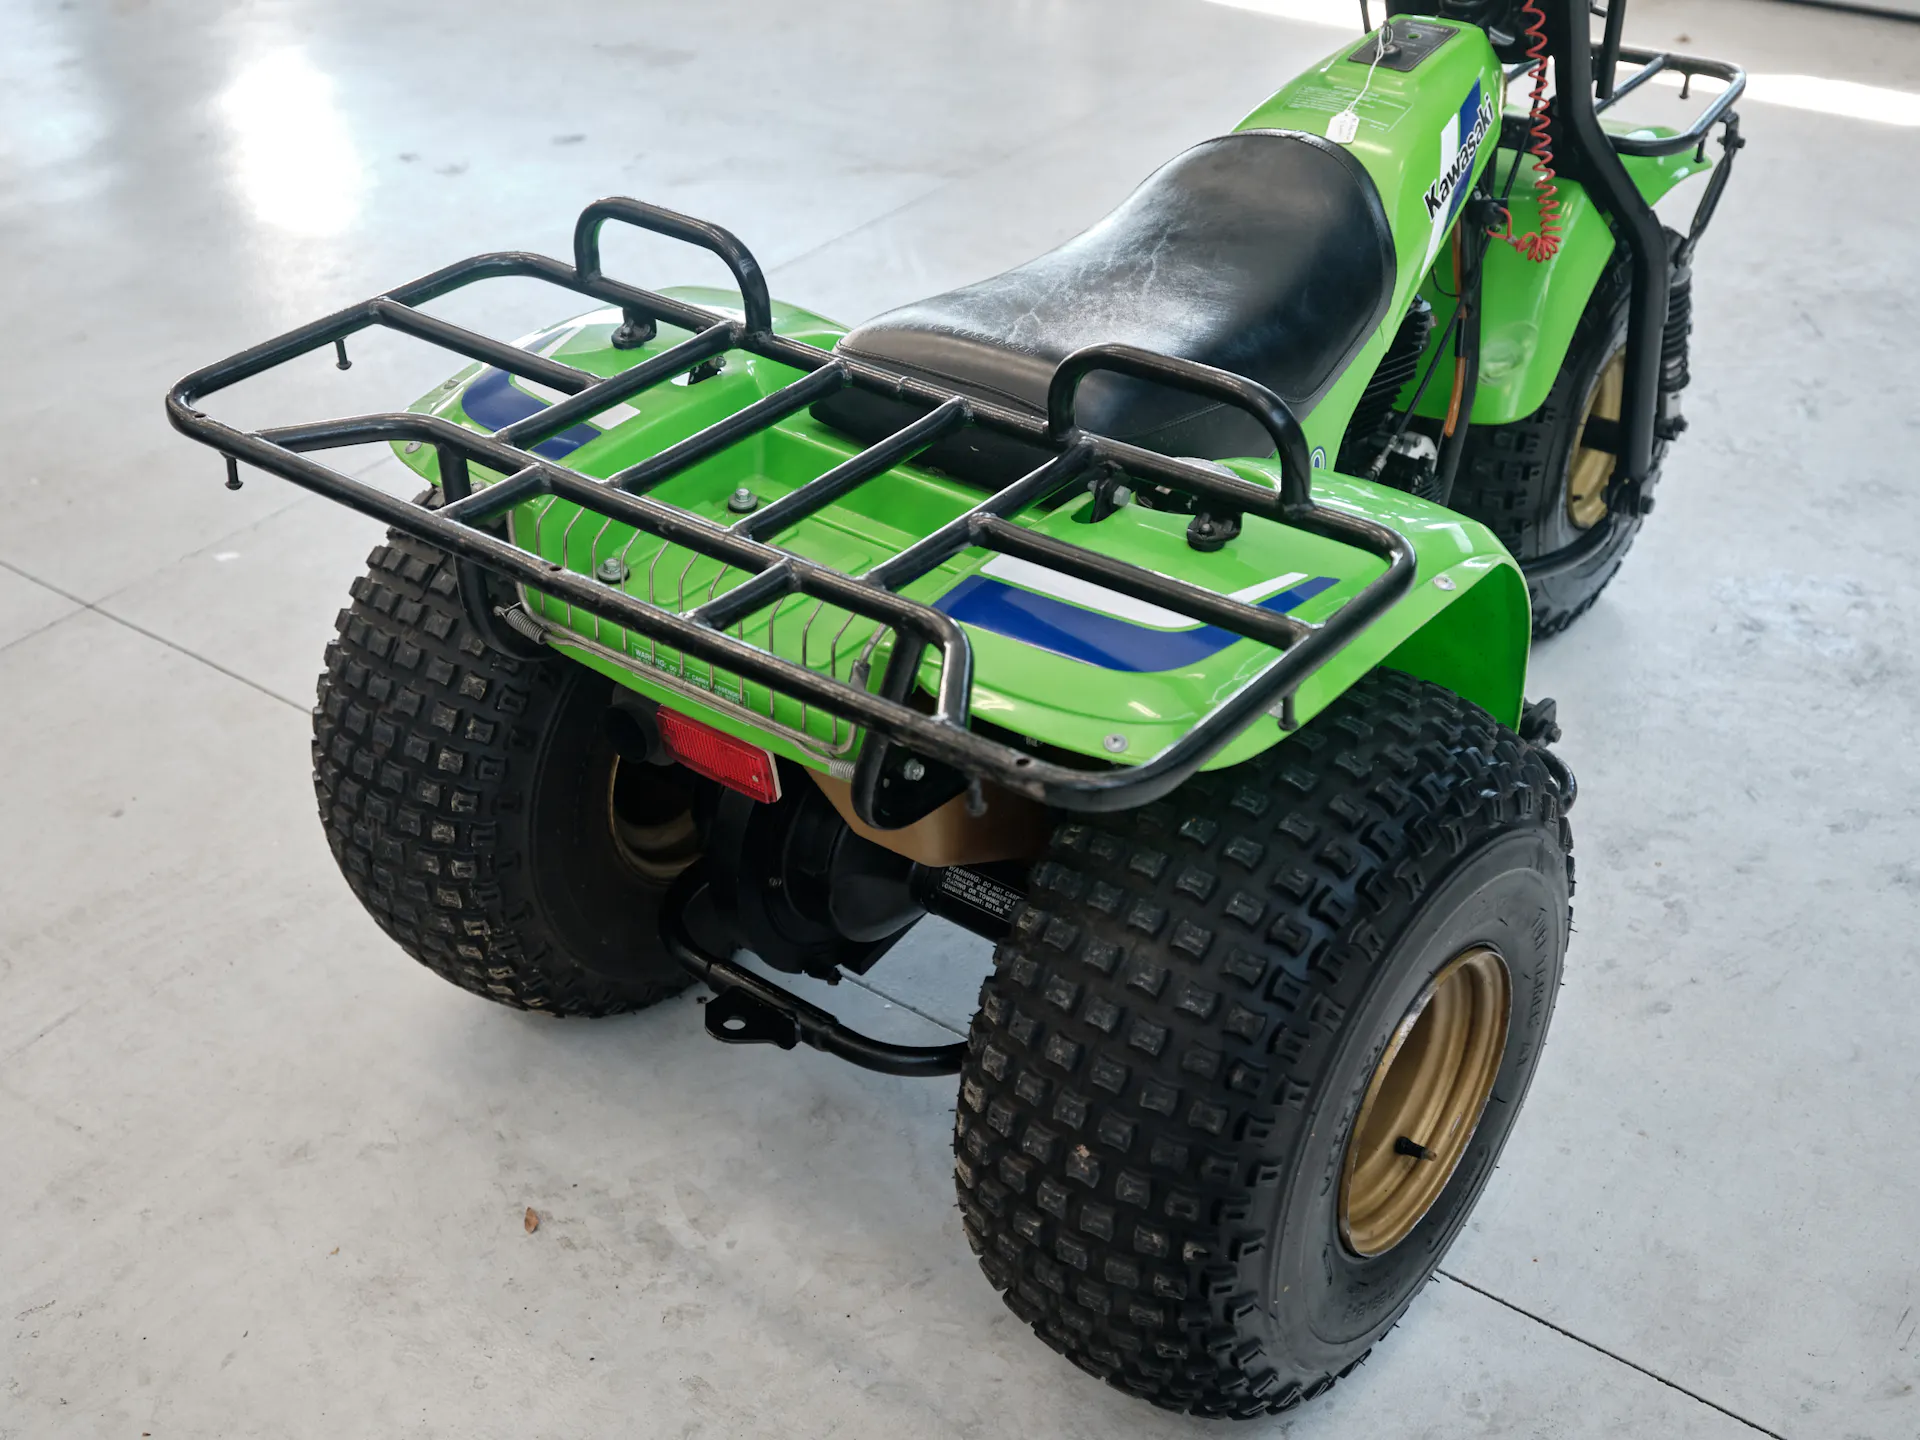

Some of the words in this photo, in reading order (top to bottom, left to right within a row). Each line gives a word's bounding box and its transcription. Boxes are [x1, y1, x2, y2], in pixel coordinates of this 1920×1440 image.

[1423, 92, 1495, 223] Kawasaki
[968, 887, 977, 896] OR
[982, 881, 992, 889] DO
[992, 885, 1004, 894] NOT
